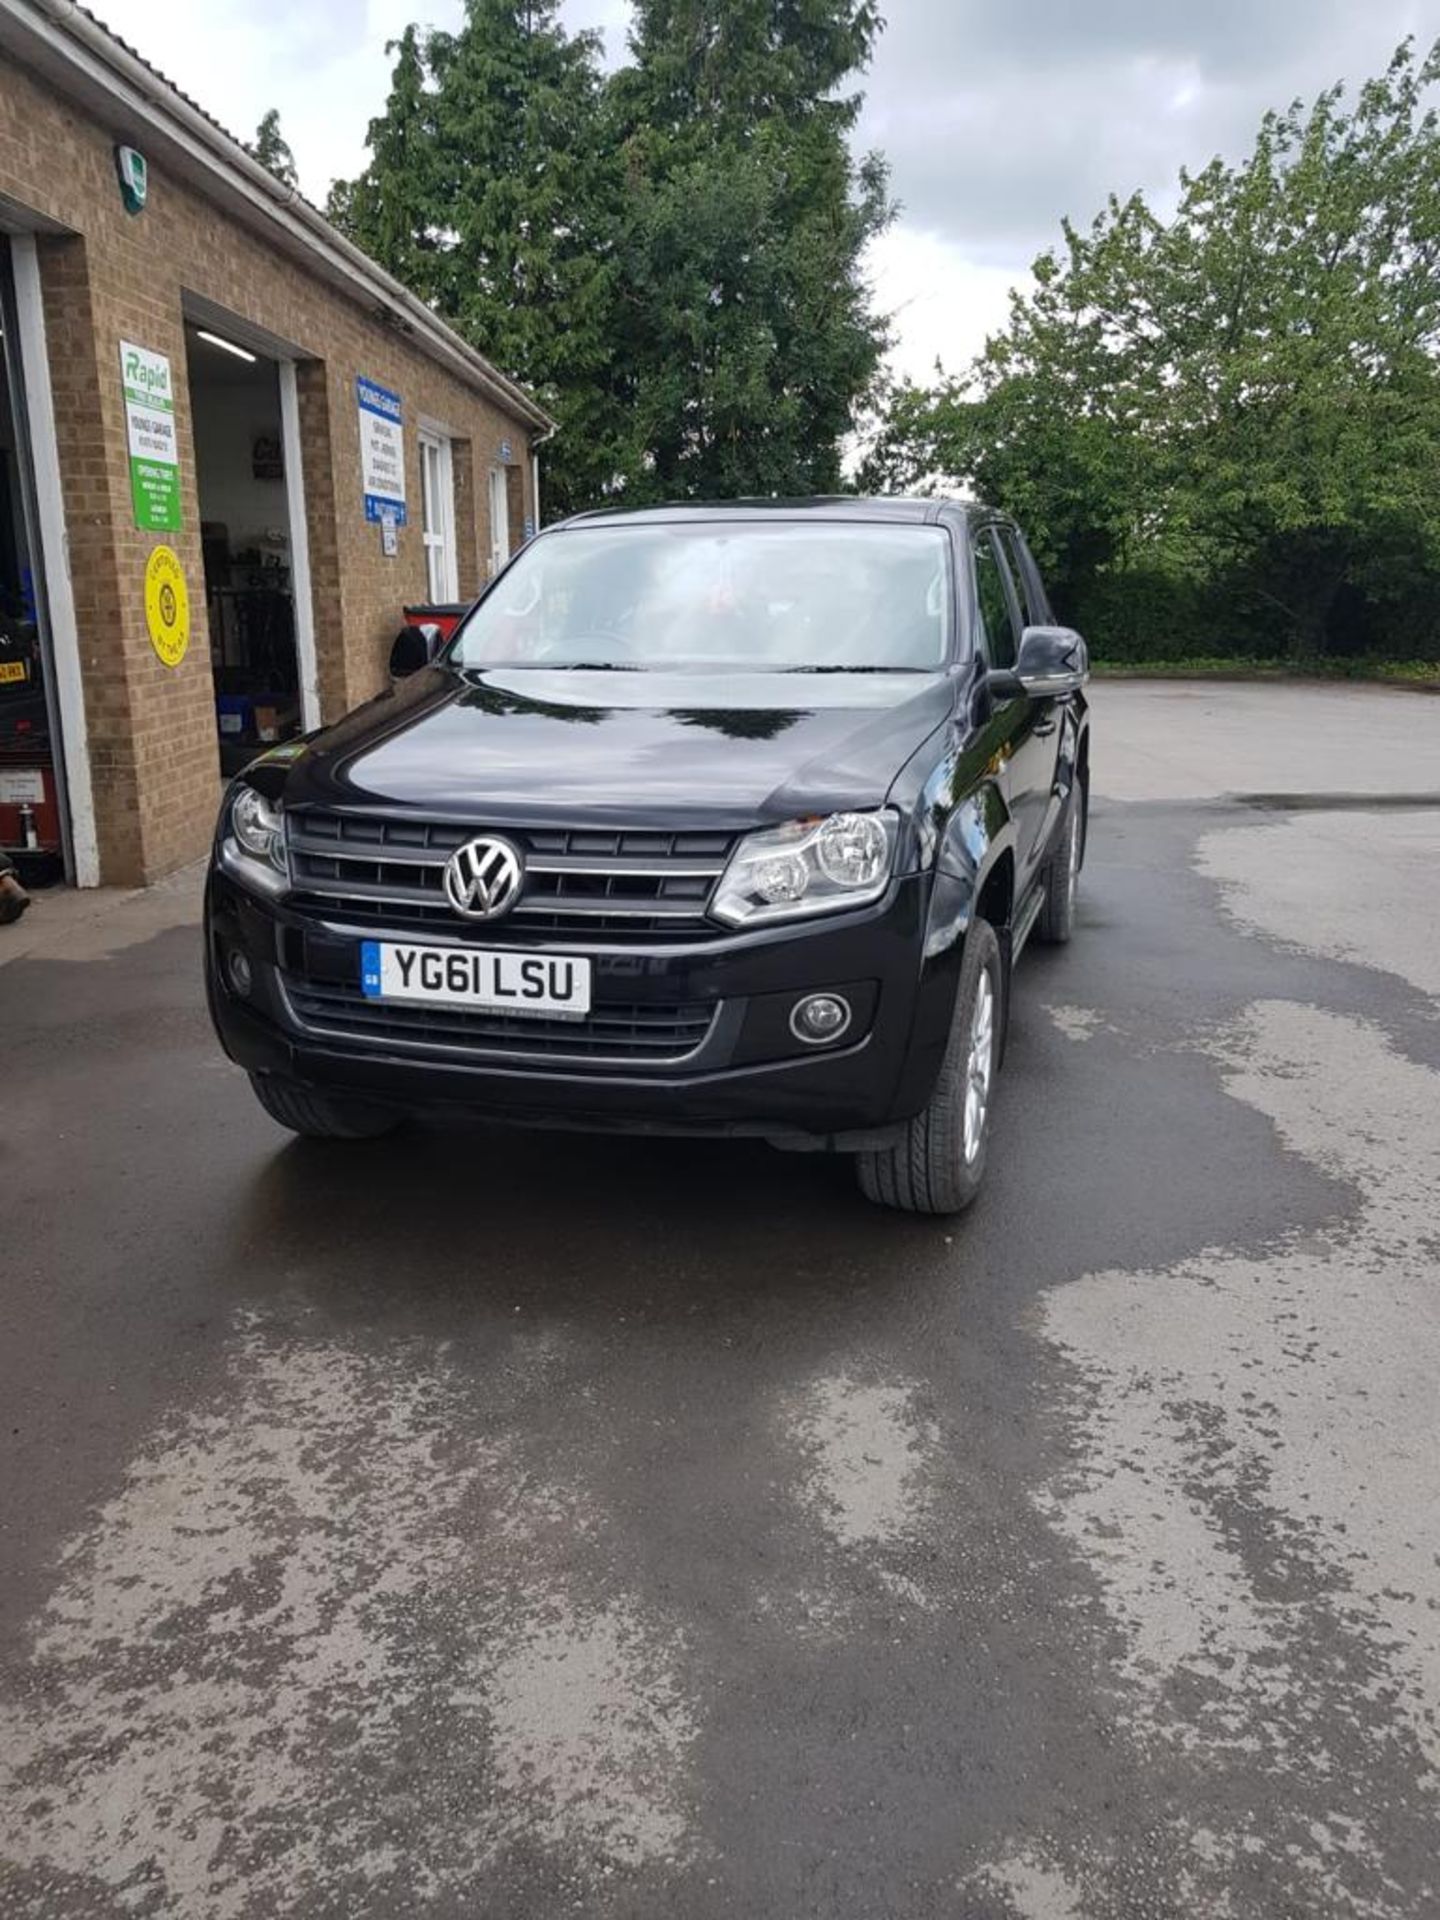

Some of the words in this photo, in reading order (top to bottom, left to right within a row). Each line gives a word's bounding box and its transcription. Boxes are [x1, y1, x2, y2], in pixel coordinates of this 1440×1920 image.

[126, 352, 168, 391] Rapid
[395, 949, 480, 995] YG61
[494, 957, 573, 1001] LSU
